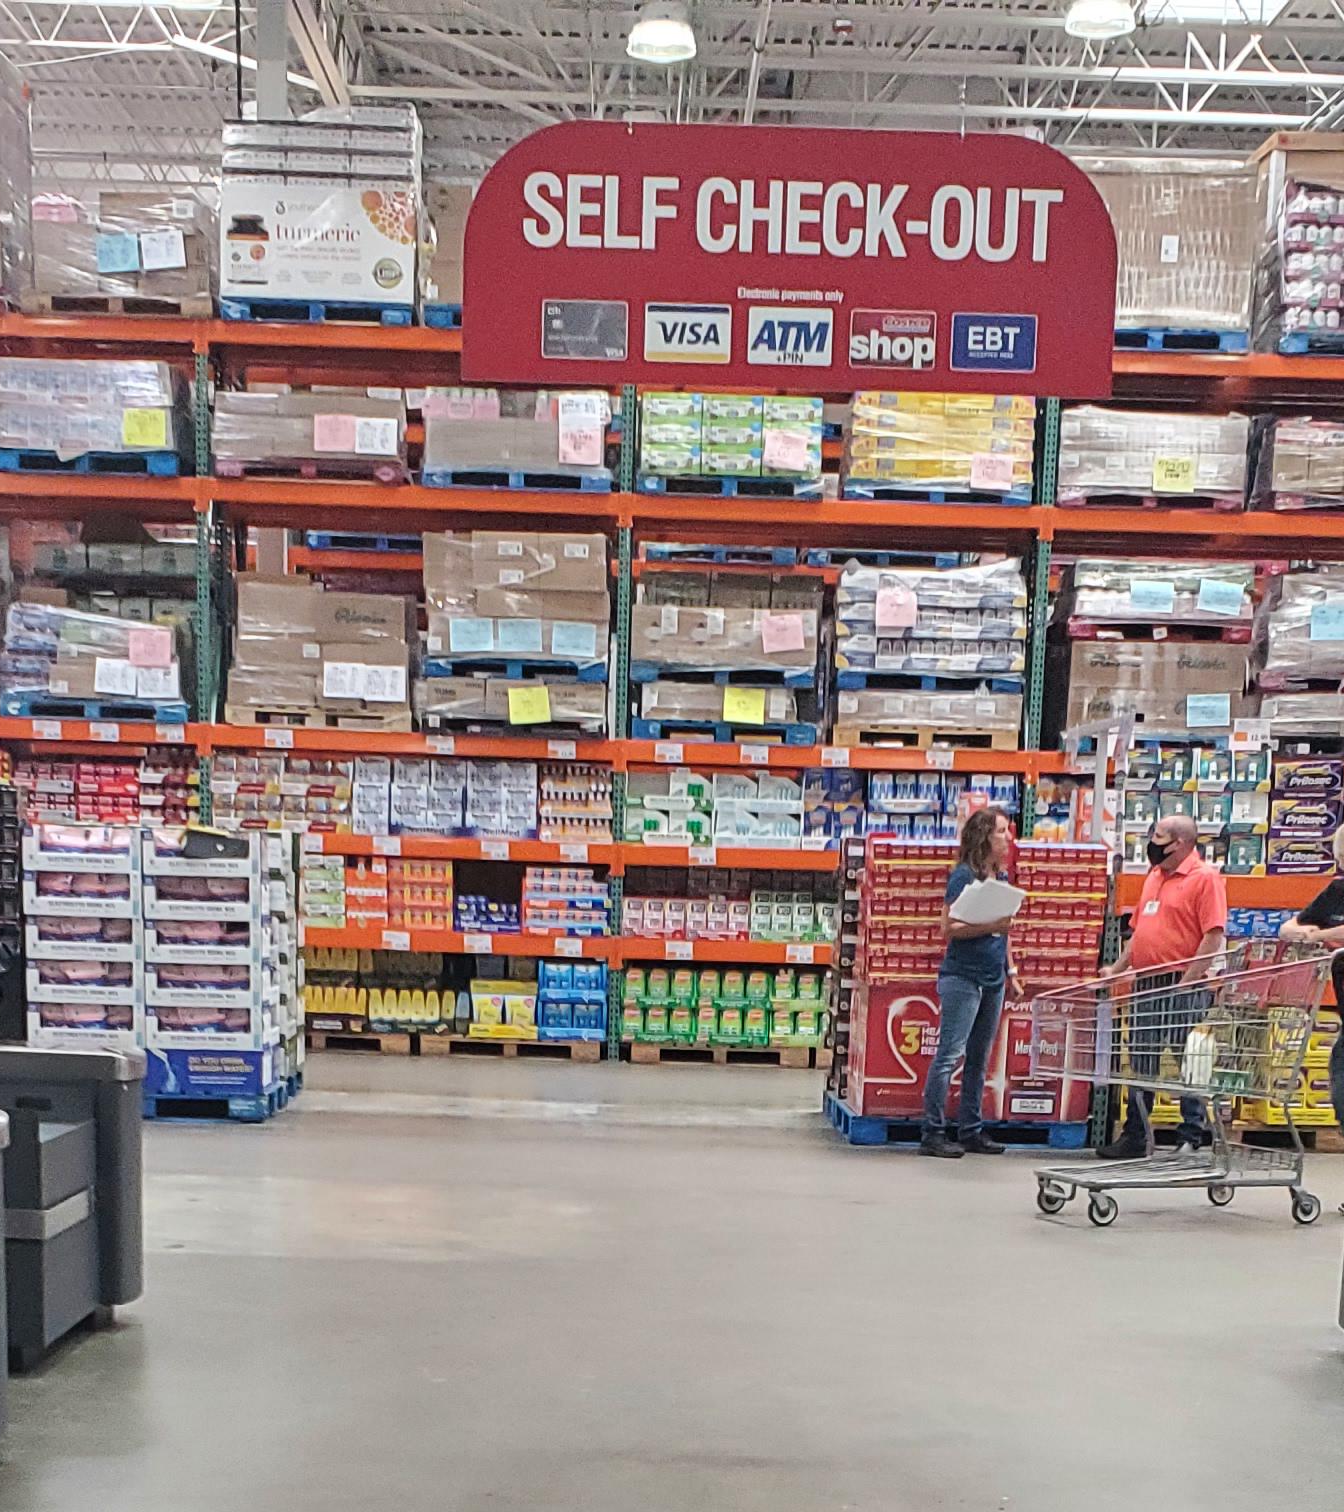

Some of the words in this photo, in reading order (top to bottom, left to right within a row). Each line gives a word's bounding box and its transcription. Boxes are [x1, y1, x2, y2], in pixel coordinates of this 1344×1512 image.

[522, 171, 679, 250] SELF
[696, 176, 1064, 262] CHECK-OUT
[276, 223, 360, 242] turmeric
[781, 290, 823, 302] payments
[825, 290, 843, 304] only
[657, 321, 720, 345] VISA
[751, 320, 829, 351] ATM
[967, 326, 1020, 351] EBT
[851, 330, 935, 369] shop
[1290, 775, 1333, 787] Prilosec
[1285, 814, 1328, 826] Prilosec
[1281, 850, 1324, 863] Prilosec
[900, 1025, 920, 1055] 3
